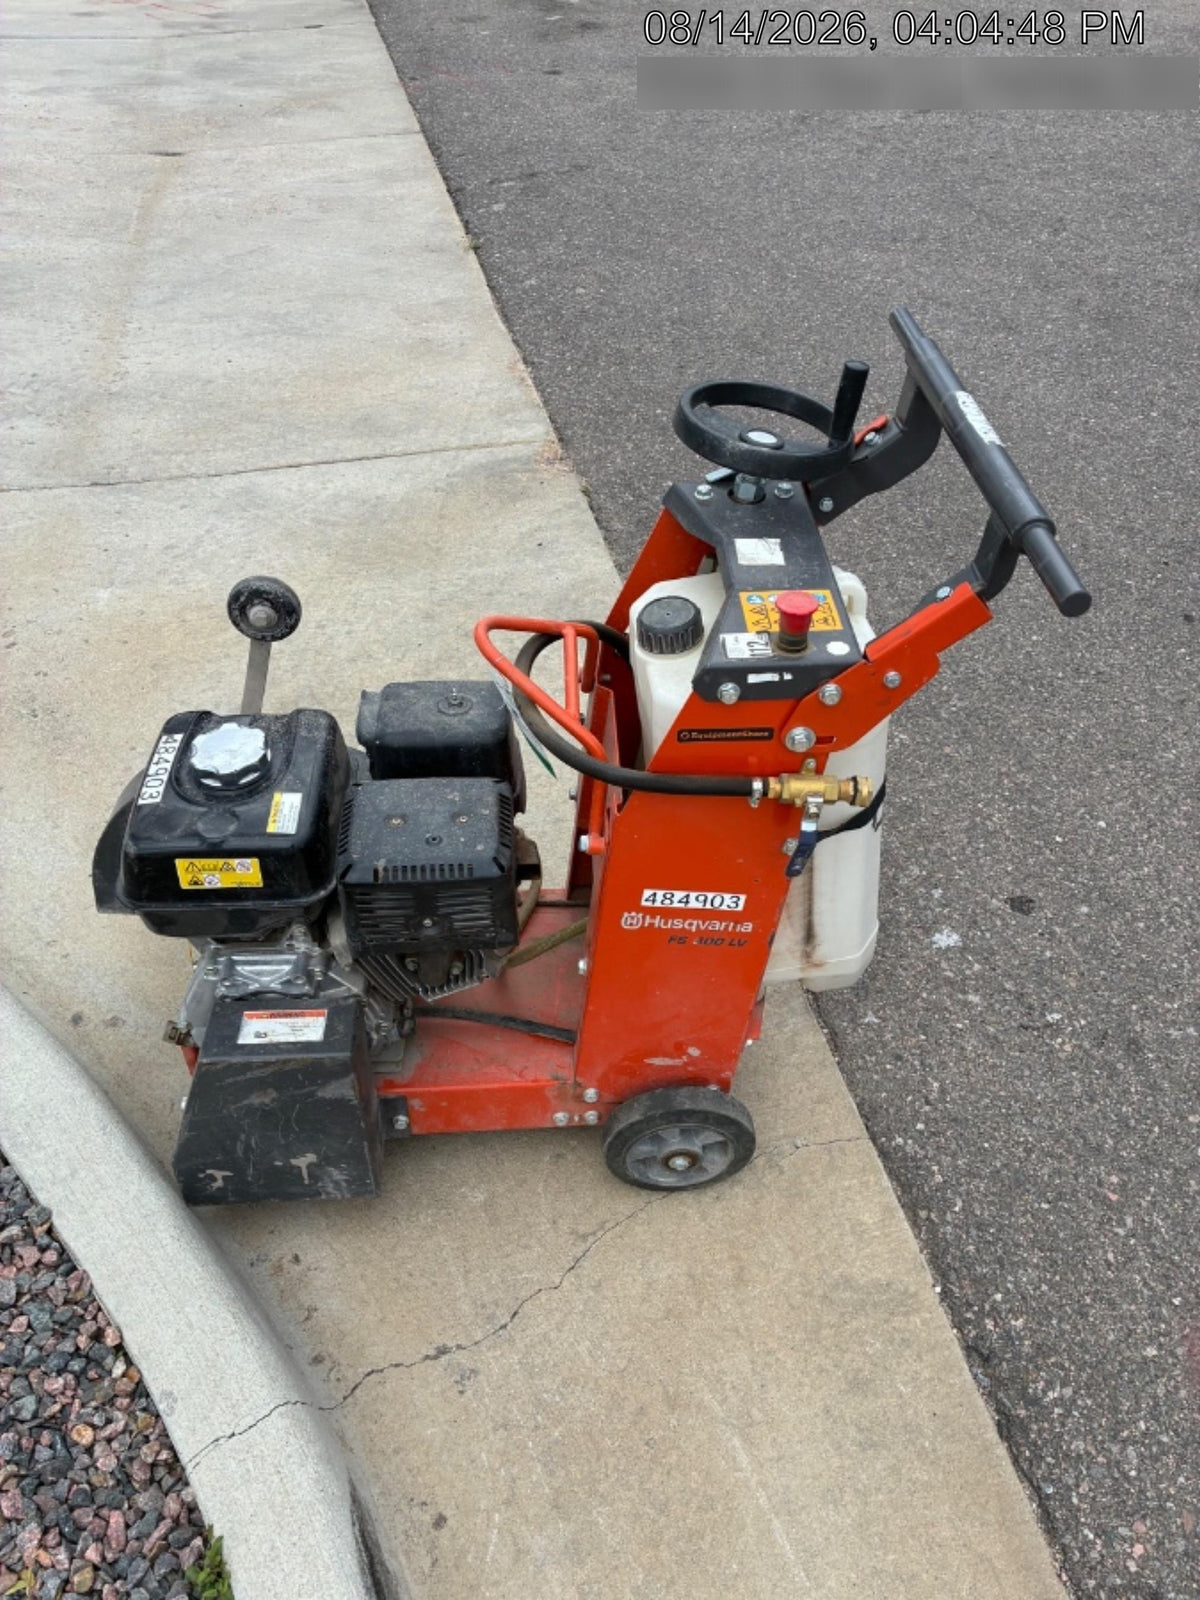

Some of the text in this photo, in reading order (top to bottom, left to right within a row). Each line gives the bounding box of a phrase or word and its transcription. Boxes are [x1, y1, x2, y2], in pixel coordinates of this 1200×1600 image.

[141, 735, 178, 800] 484903
[644, 891, 741, 910] 484903
[644, 914, 754, 932] Husqvarna
[667, 934, 688, 945] FS
[728, 937, 747, 947] LV
